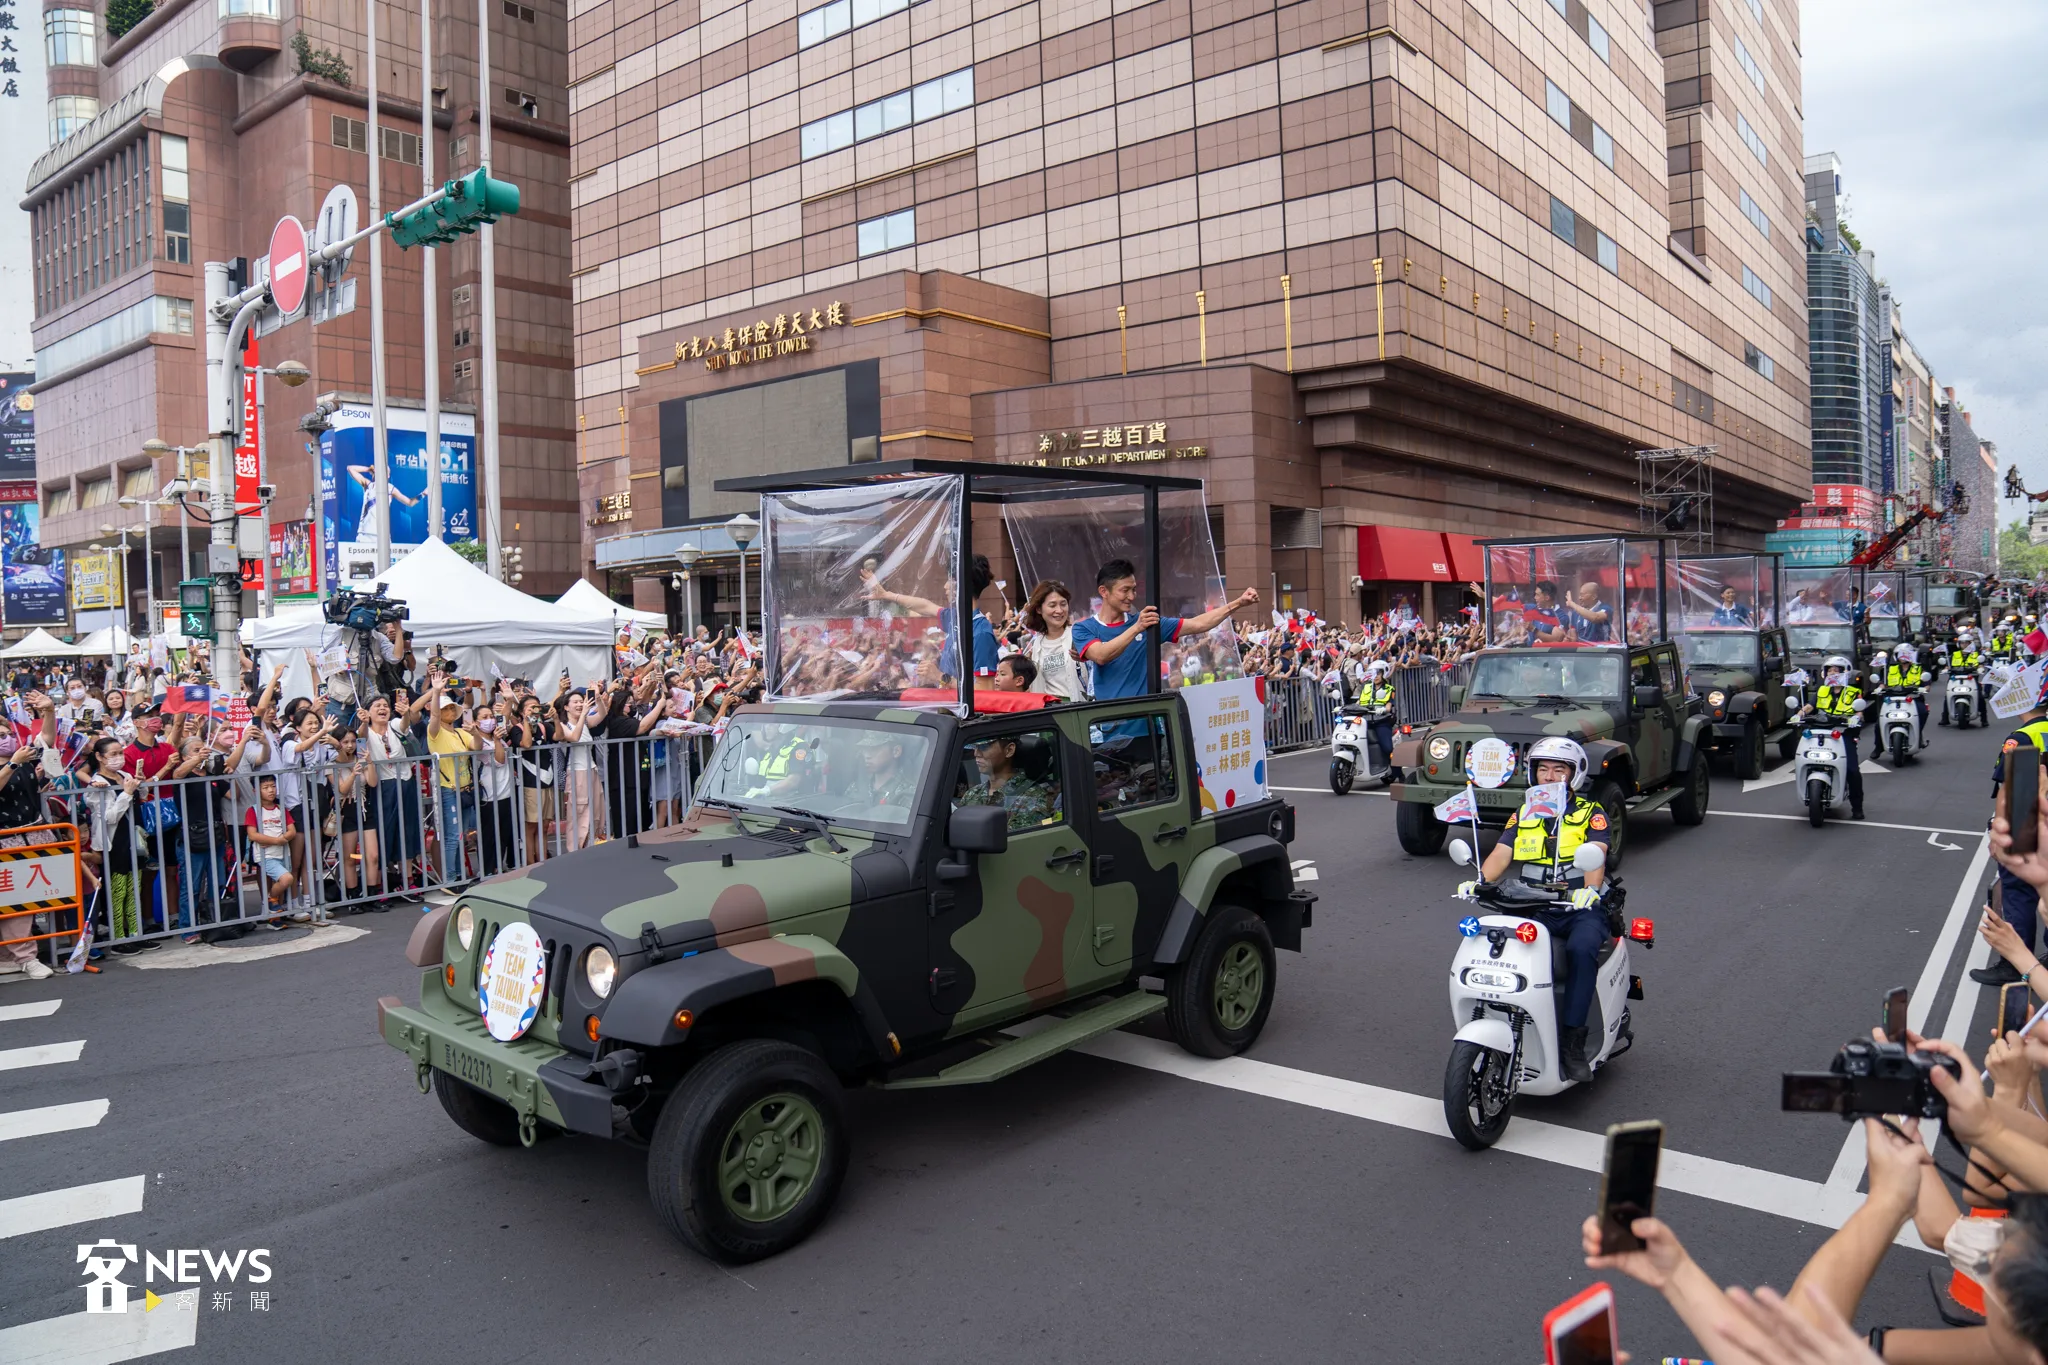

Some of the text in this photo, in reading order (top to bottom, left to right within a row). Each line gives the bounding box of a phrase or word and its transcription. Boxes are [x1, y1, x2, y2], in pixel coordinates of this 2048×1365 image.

[675, 300, 845, 362] 新光人壽保險摩天大樓
[705, 353, 727, 371] SHIN
[729, 349, 750, 367] KONG
[753, 342, 773, 361] LIFE
[341, 409, 371, 419] EPSON
[1039, 421, 1167, 453] 新光三越百貨
[1111, 448, 1171, 463] DEPARTMENT
[1175, 446, 1207, 458] STORE
[1220, 729, 1251, 752] 曾自強
[1219, 750, 1251, 773] 林郁婷
[1477, 761, 1502, 772] TAIWAN
[1482, 751, 1499, 761] TEAM
[44, 888, 60, 896] 110
[503, 951, 526, 979] TEAM
[494, 974, 526, 1005] TAIWAN
